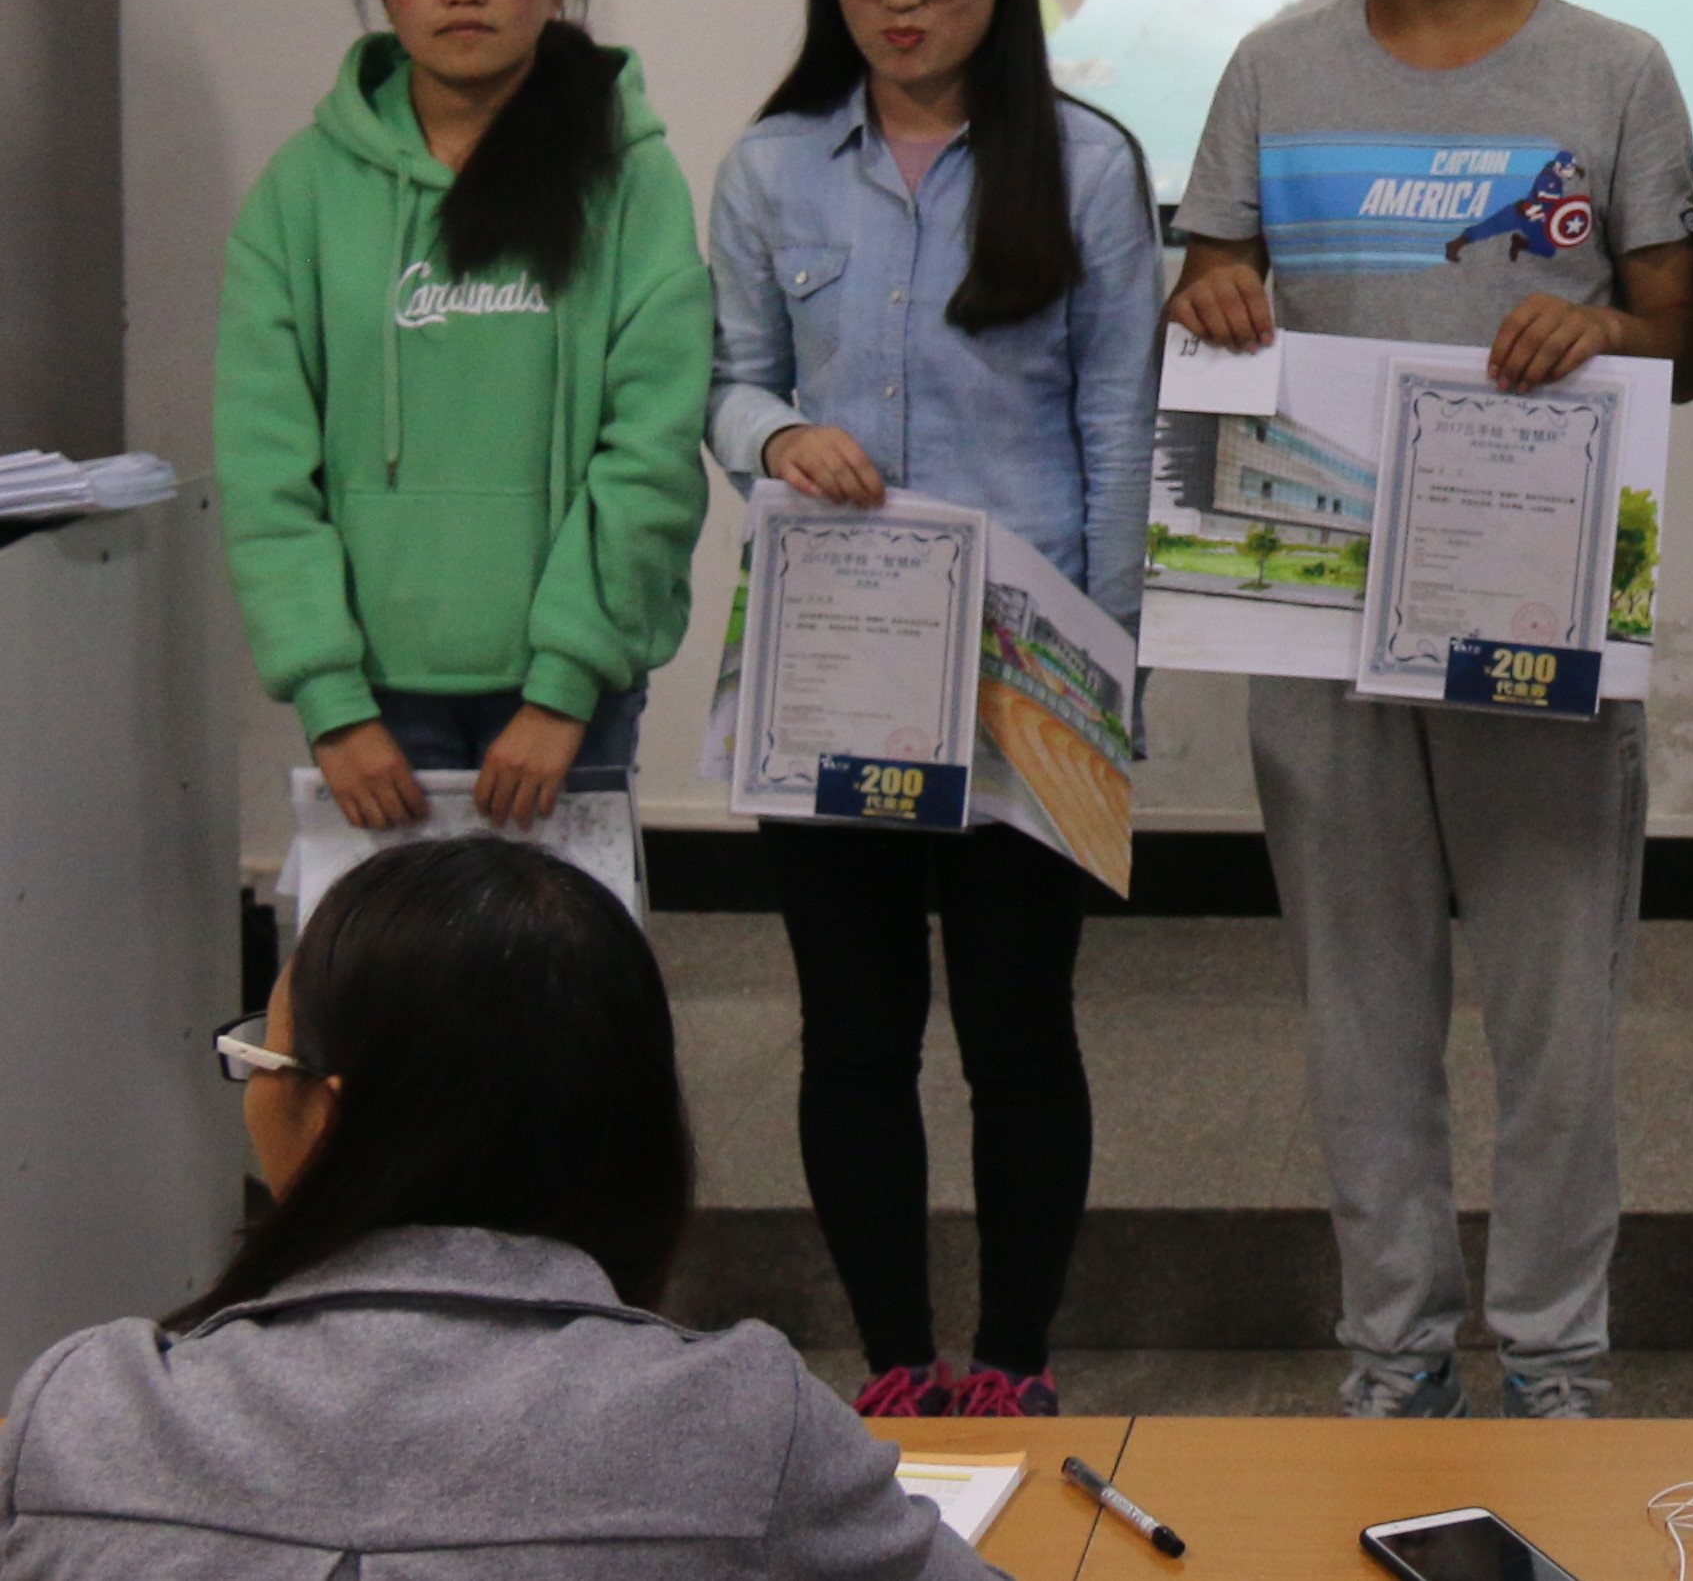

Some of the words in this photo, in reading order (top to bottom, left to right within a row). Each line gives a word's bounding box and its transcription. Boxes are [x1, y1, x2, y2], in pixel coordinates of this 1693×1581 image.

[1430, 149, 1511, 177] CAPTAIN
[1357, 179, 1493, 219] AMERICA
[395, 261, 550, 328] Cardinals
